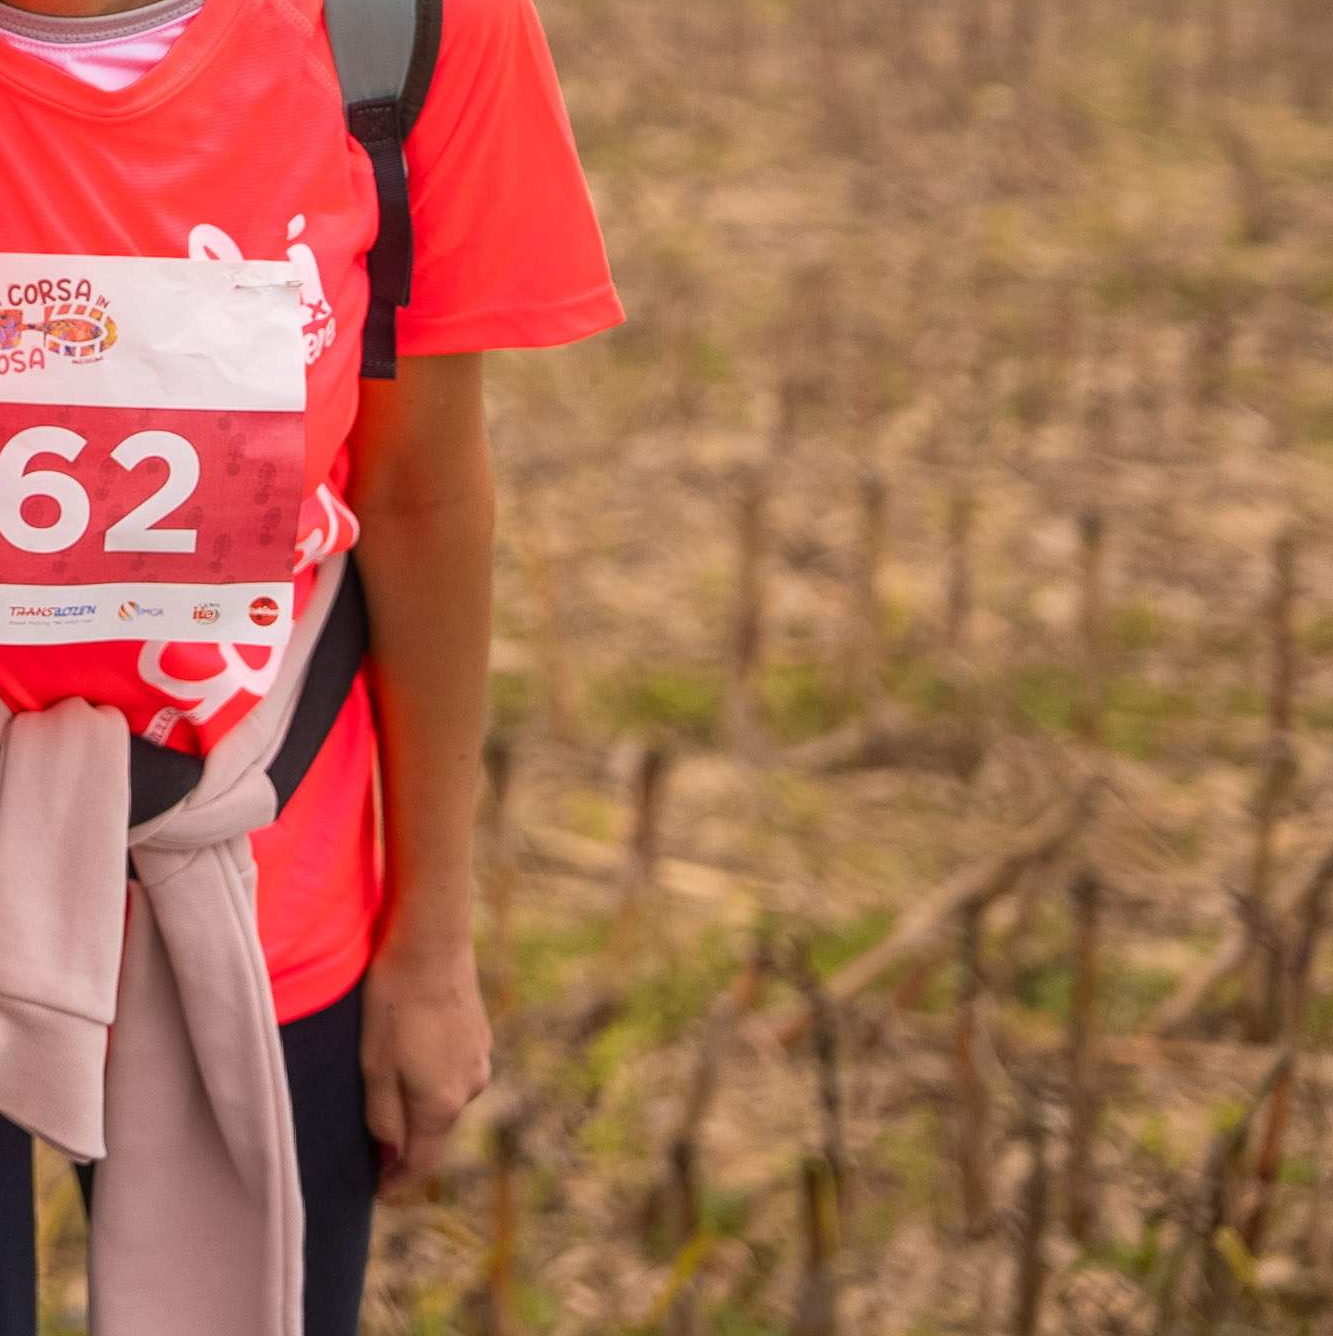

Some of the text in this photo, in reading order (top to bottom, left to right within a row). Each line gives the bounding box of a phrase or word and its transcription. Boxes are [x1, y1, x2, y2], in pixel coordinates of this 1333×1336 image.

[7, 278, 91, 306] CORSA
[96, 295, 110, 308] IN
[9, 605, 97, 617] TRANSBOZEN
